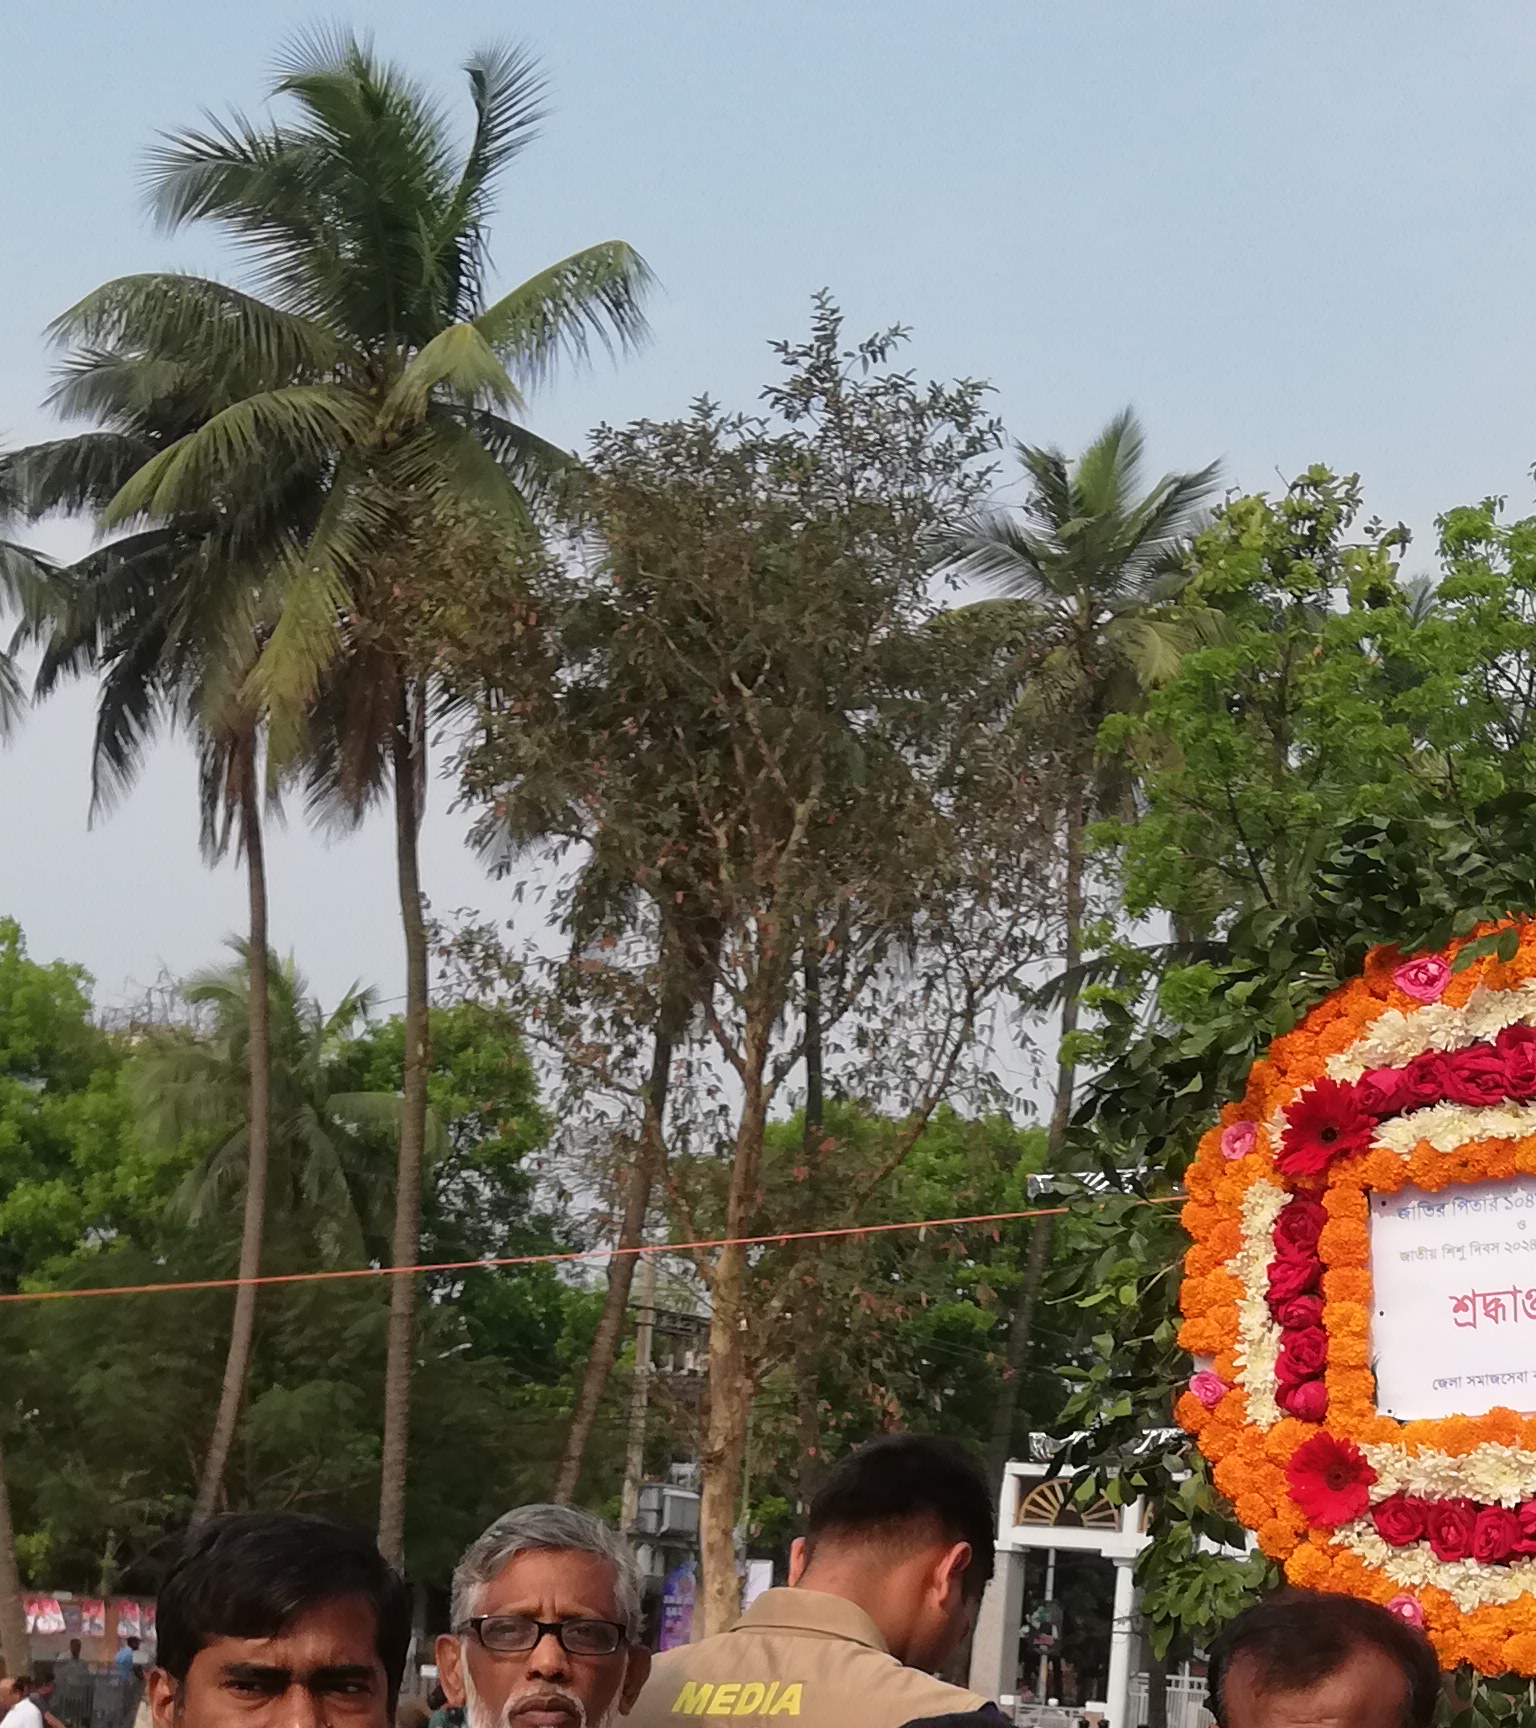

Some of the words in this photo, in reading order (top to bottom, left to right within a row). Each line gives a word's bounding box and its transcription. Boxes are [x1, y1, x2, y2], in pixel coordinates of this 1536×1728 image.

[1397, 1200, 1446, 1221] জাতির
[1452, 1195, 1498, 1217] পিতার
[1517, 1217, 1527, 1231] ও
[1399, 1244, 1438, 1263] জাতীয়
[1441, 1242, 1467, 1262] শিশু
[1469, 1240, 1500, 1257] দিবস
[1432, 1375, 1462, 1391] জেলা
[1466, 1370, 1529, 1389] সমাজসেবা
[671, 1680, 804, 1716] MEDIA
